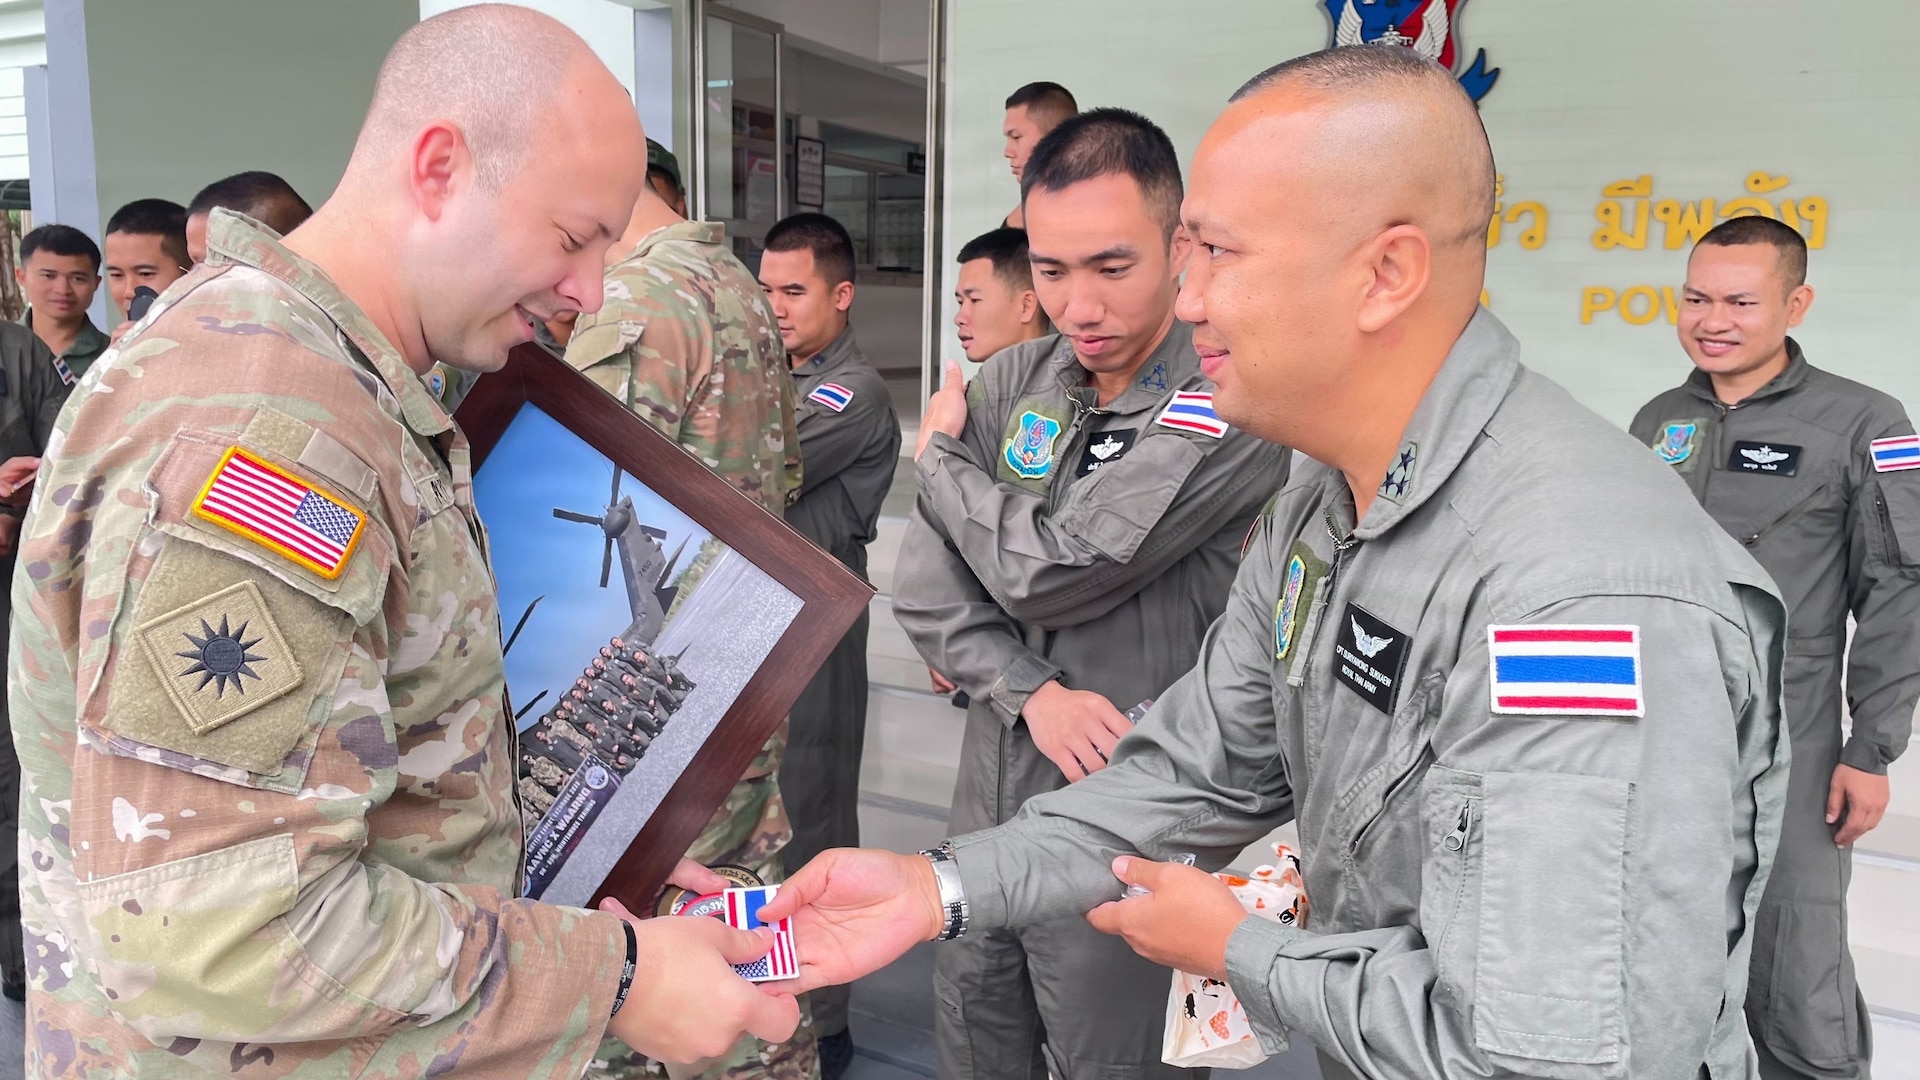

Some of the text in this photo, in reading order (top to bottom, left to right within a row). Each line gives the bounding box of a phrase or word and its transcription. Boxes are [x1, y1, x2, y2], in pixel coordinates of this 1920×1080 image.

[1342, 664, 1378, 694] ROYAL THAI ARMY
[525, 839, 553, 874] AAVNC
[549, 829, 560, 841] X
[556, 786, 591, 832] WAARNG
